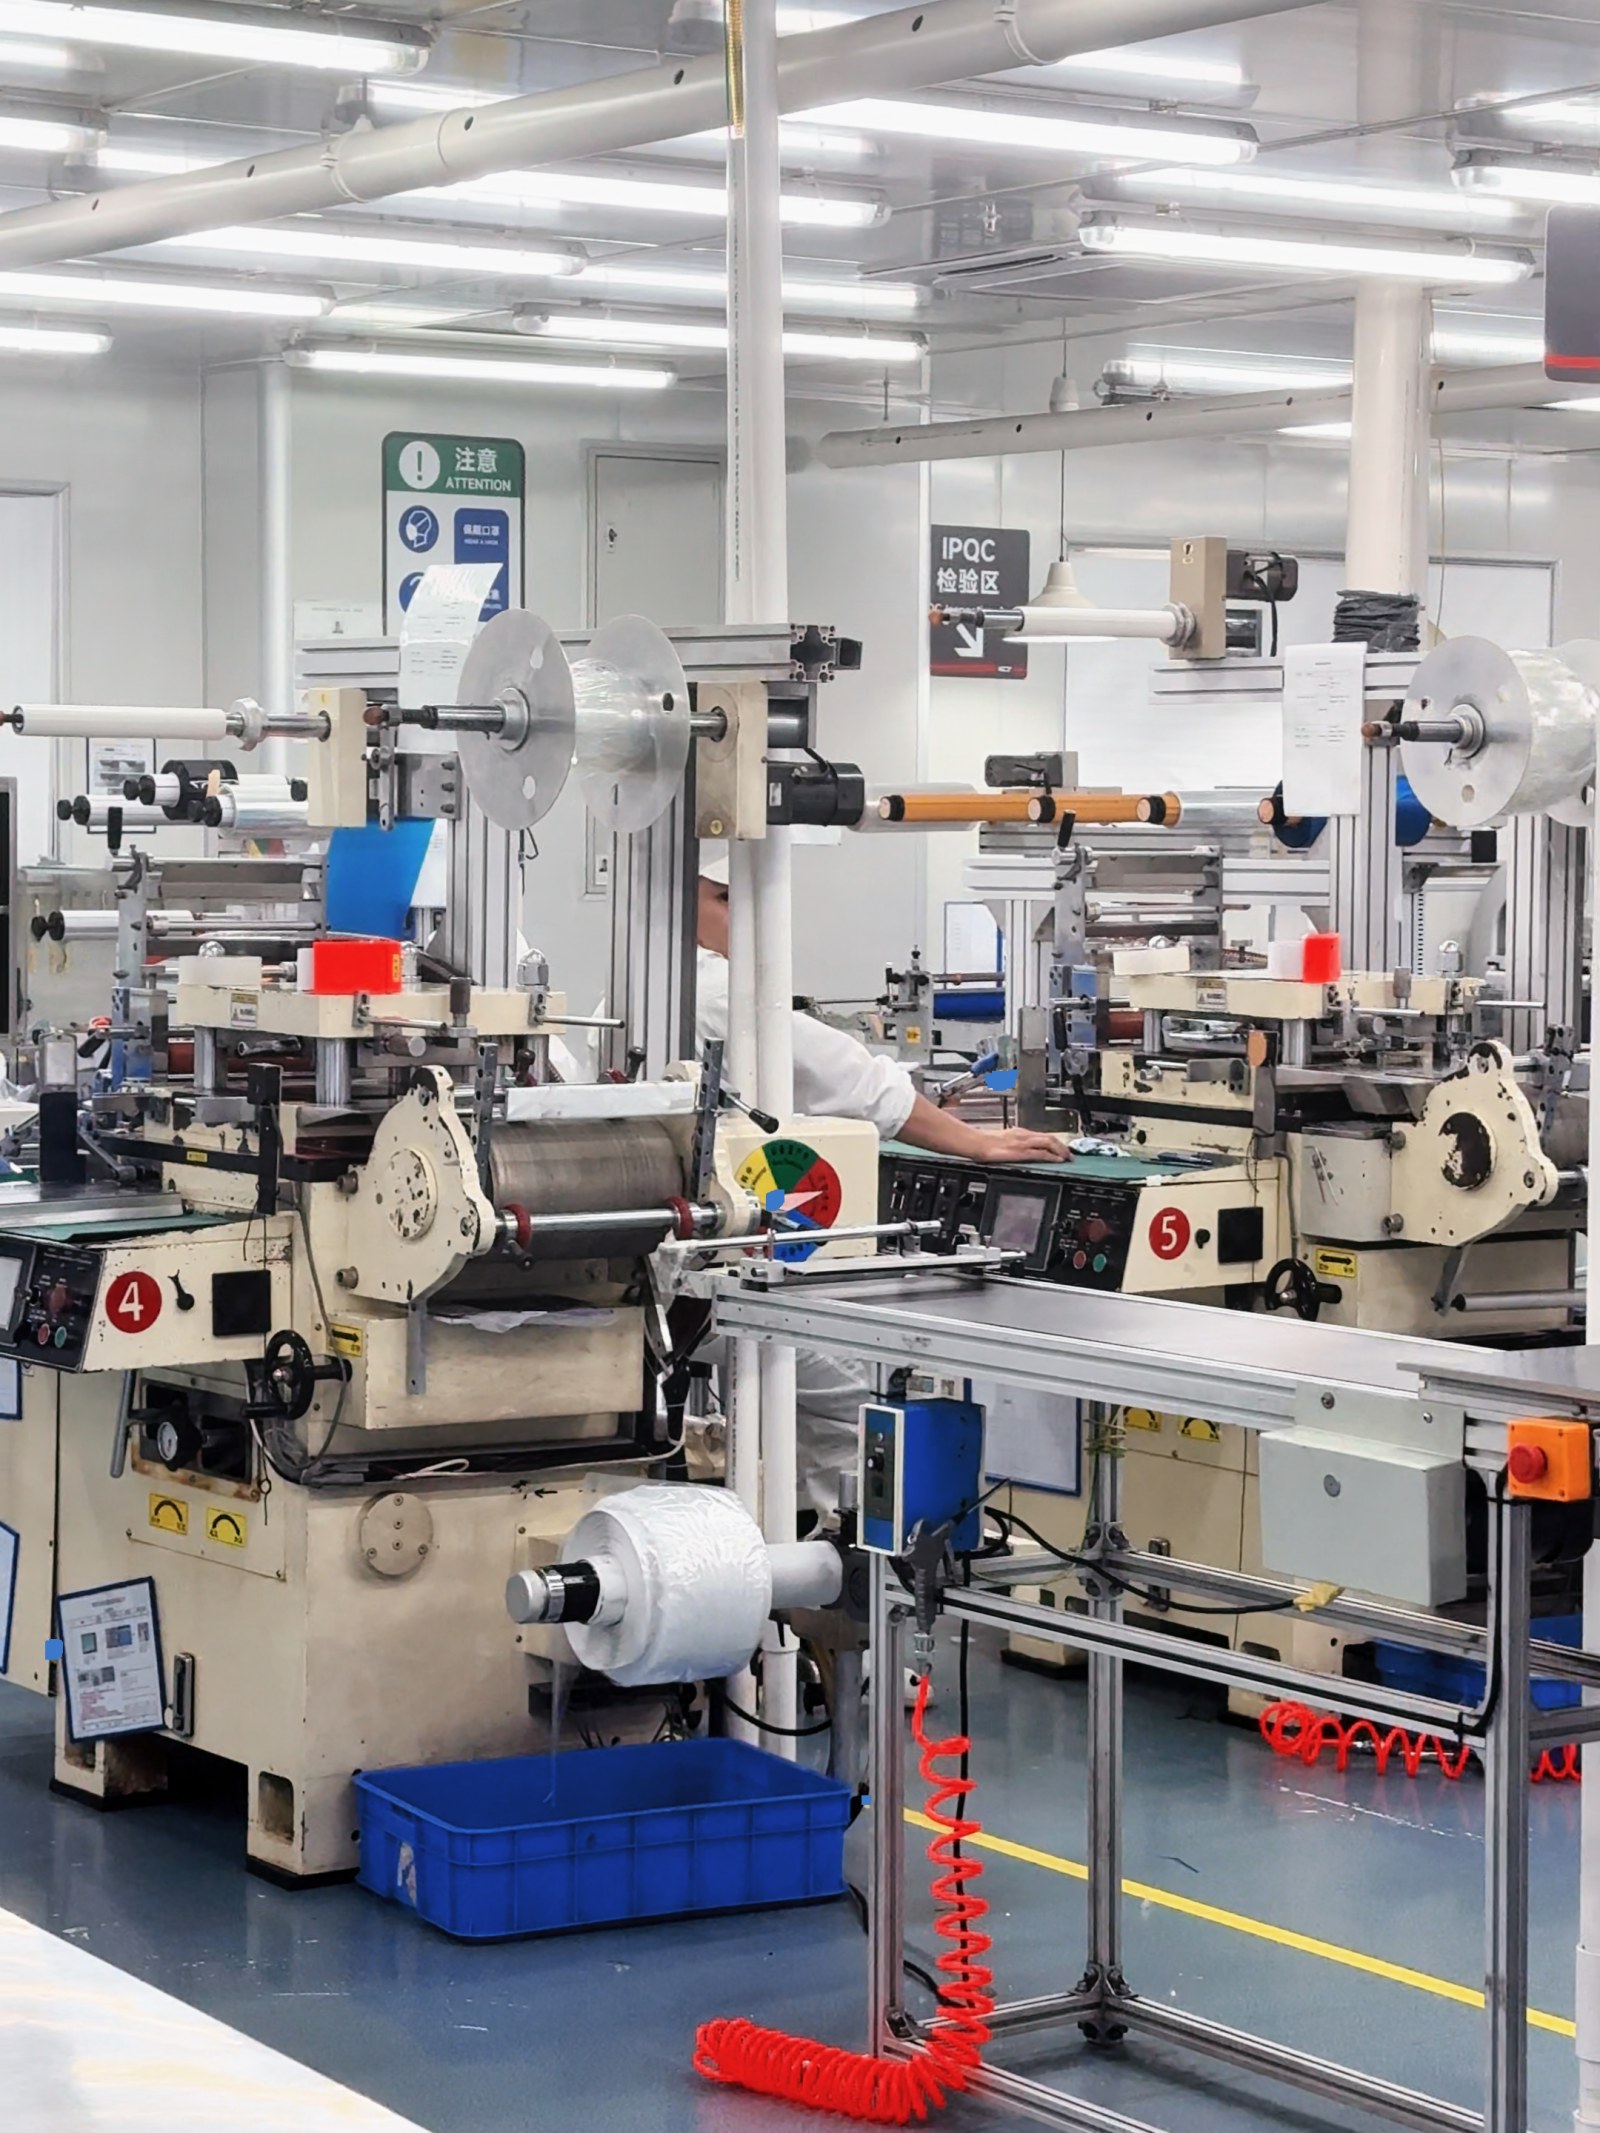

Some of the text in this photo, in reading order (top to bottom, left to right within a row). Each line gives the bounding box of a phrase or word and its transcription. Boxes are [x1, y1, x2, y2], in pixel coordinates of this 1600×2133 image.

[455, 446, 497, 473] 注意
[445, 476, 511, 491] ATTENTION
[942, 536, 996, 563] IPQC
[936, 567, 1000, 595] 检验区
[1160, 1215, 1178, 1251] 5
[118, 1281, 144, 1322] 4
